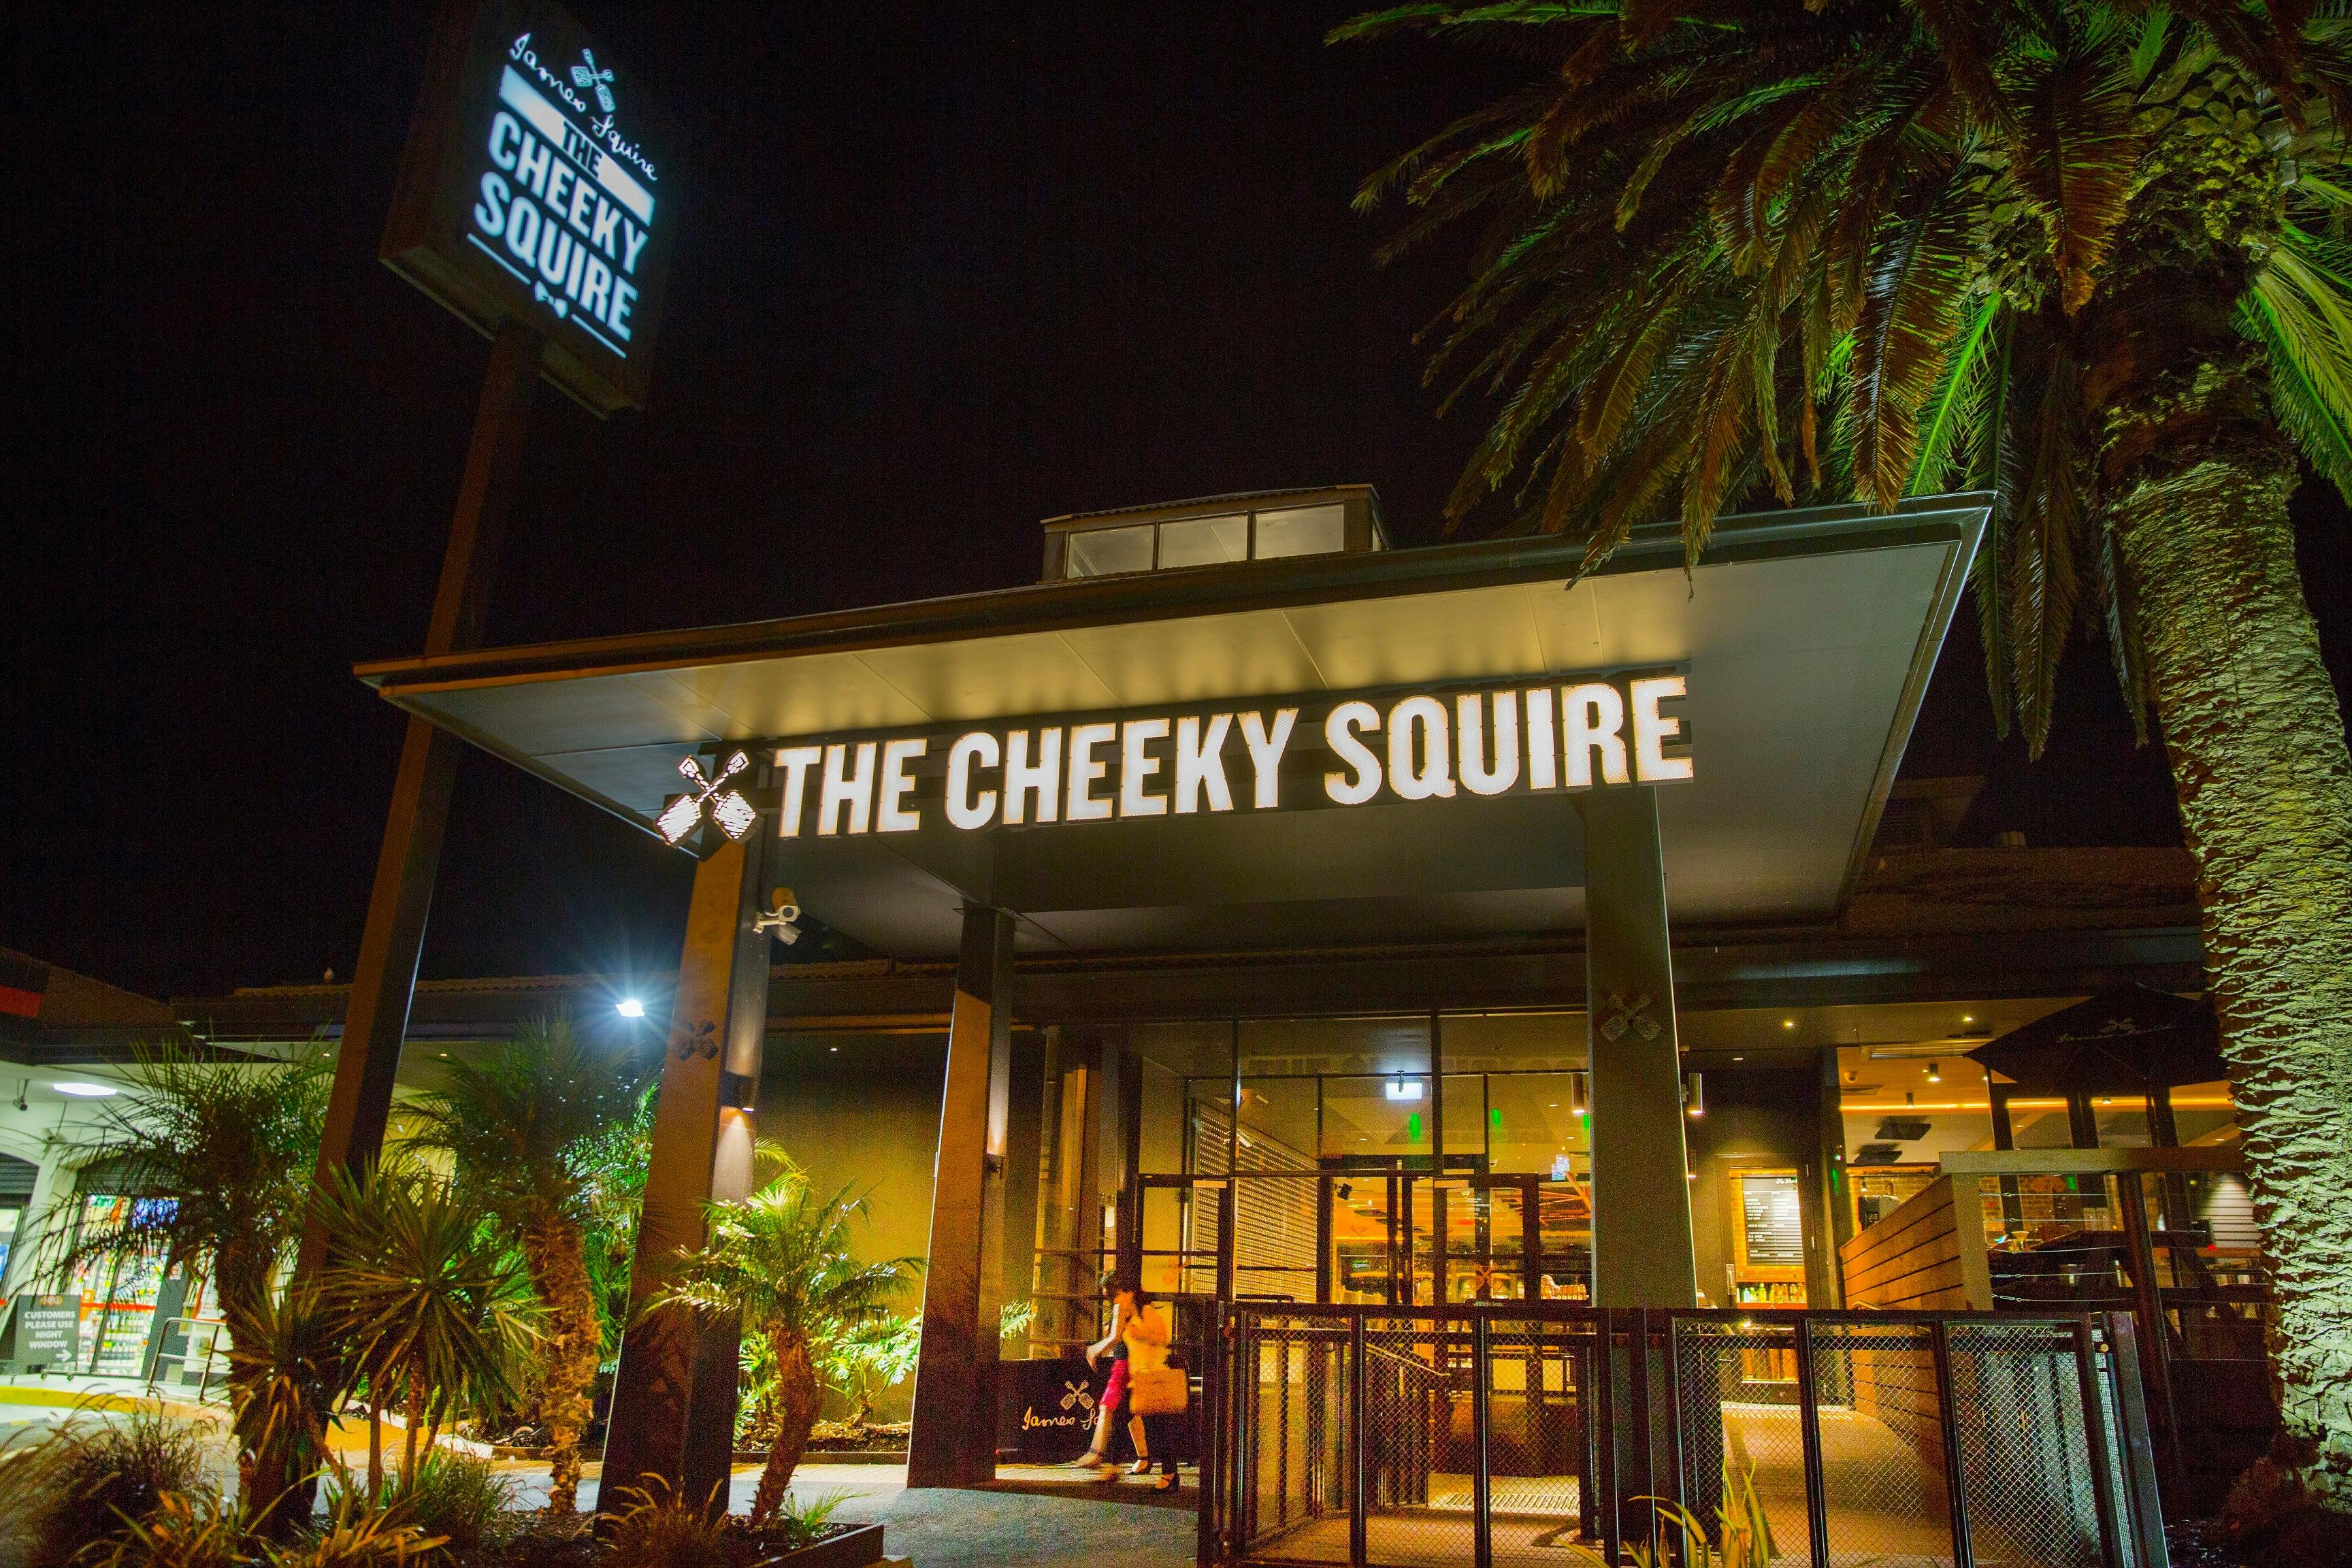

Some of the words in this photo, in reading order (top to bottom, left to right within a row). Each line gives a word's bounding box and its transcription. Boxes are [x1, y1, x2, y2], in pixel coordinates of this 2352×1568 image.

[510, 32, 586, 112] James
[589, 114, 658, 181] Squire
[560, 120, 604, 178] THE
[488, 111, 649, 275] CHEEKY
[474, 171, 639, 342] SQUIRE
[774, 737, 928, 838] THE
[945, 707, 1300, 830] CHEEKY
[1323, 675, 1695, 806] SQUIRE
[24, 1311, 76, 1320] CUSTOMERS
[24, 1320, 56, 1329] PLEASE
[58, 1320, 74, 1328] USE
[35, 1330, 63, 1339] NIGHT
[29, 1340, 69, 1349] WINDOW
[1022, 1405, 1076, 1431] James
